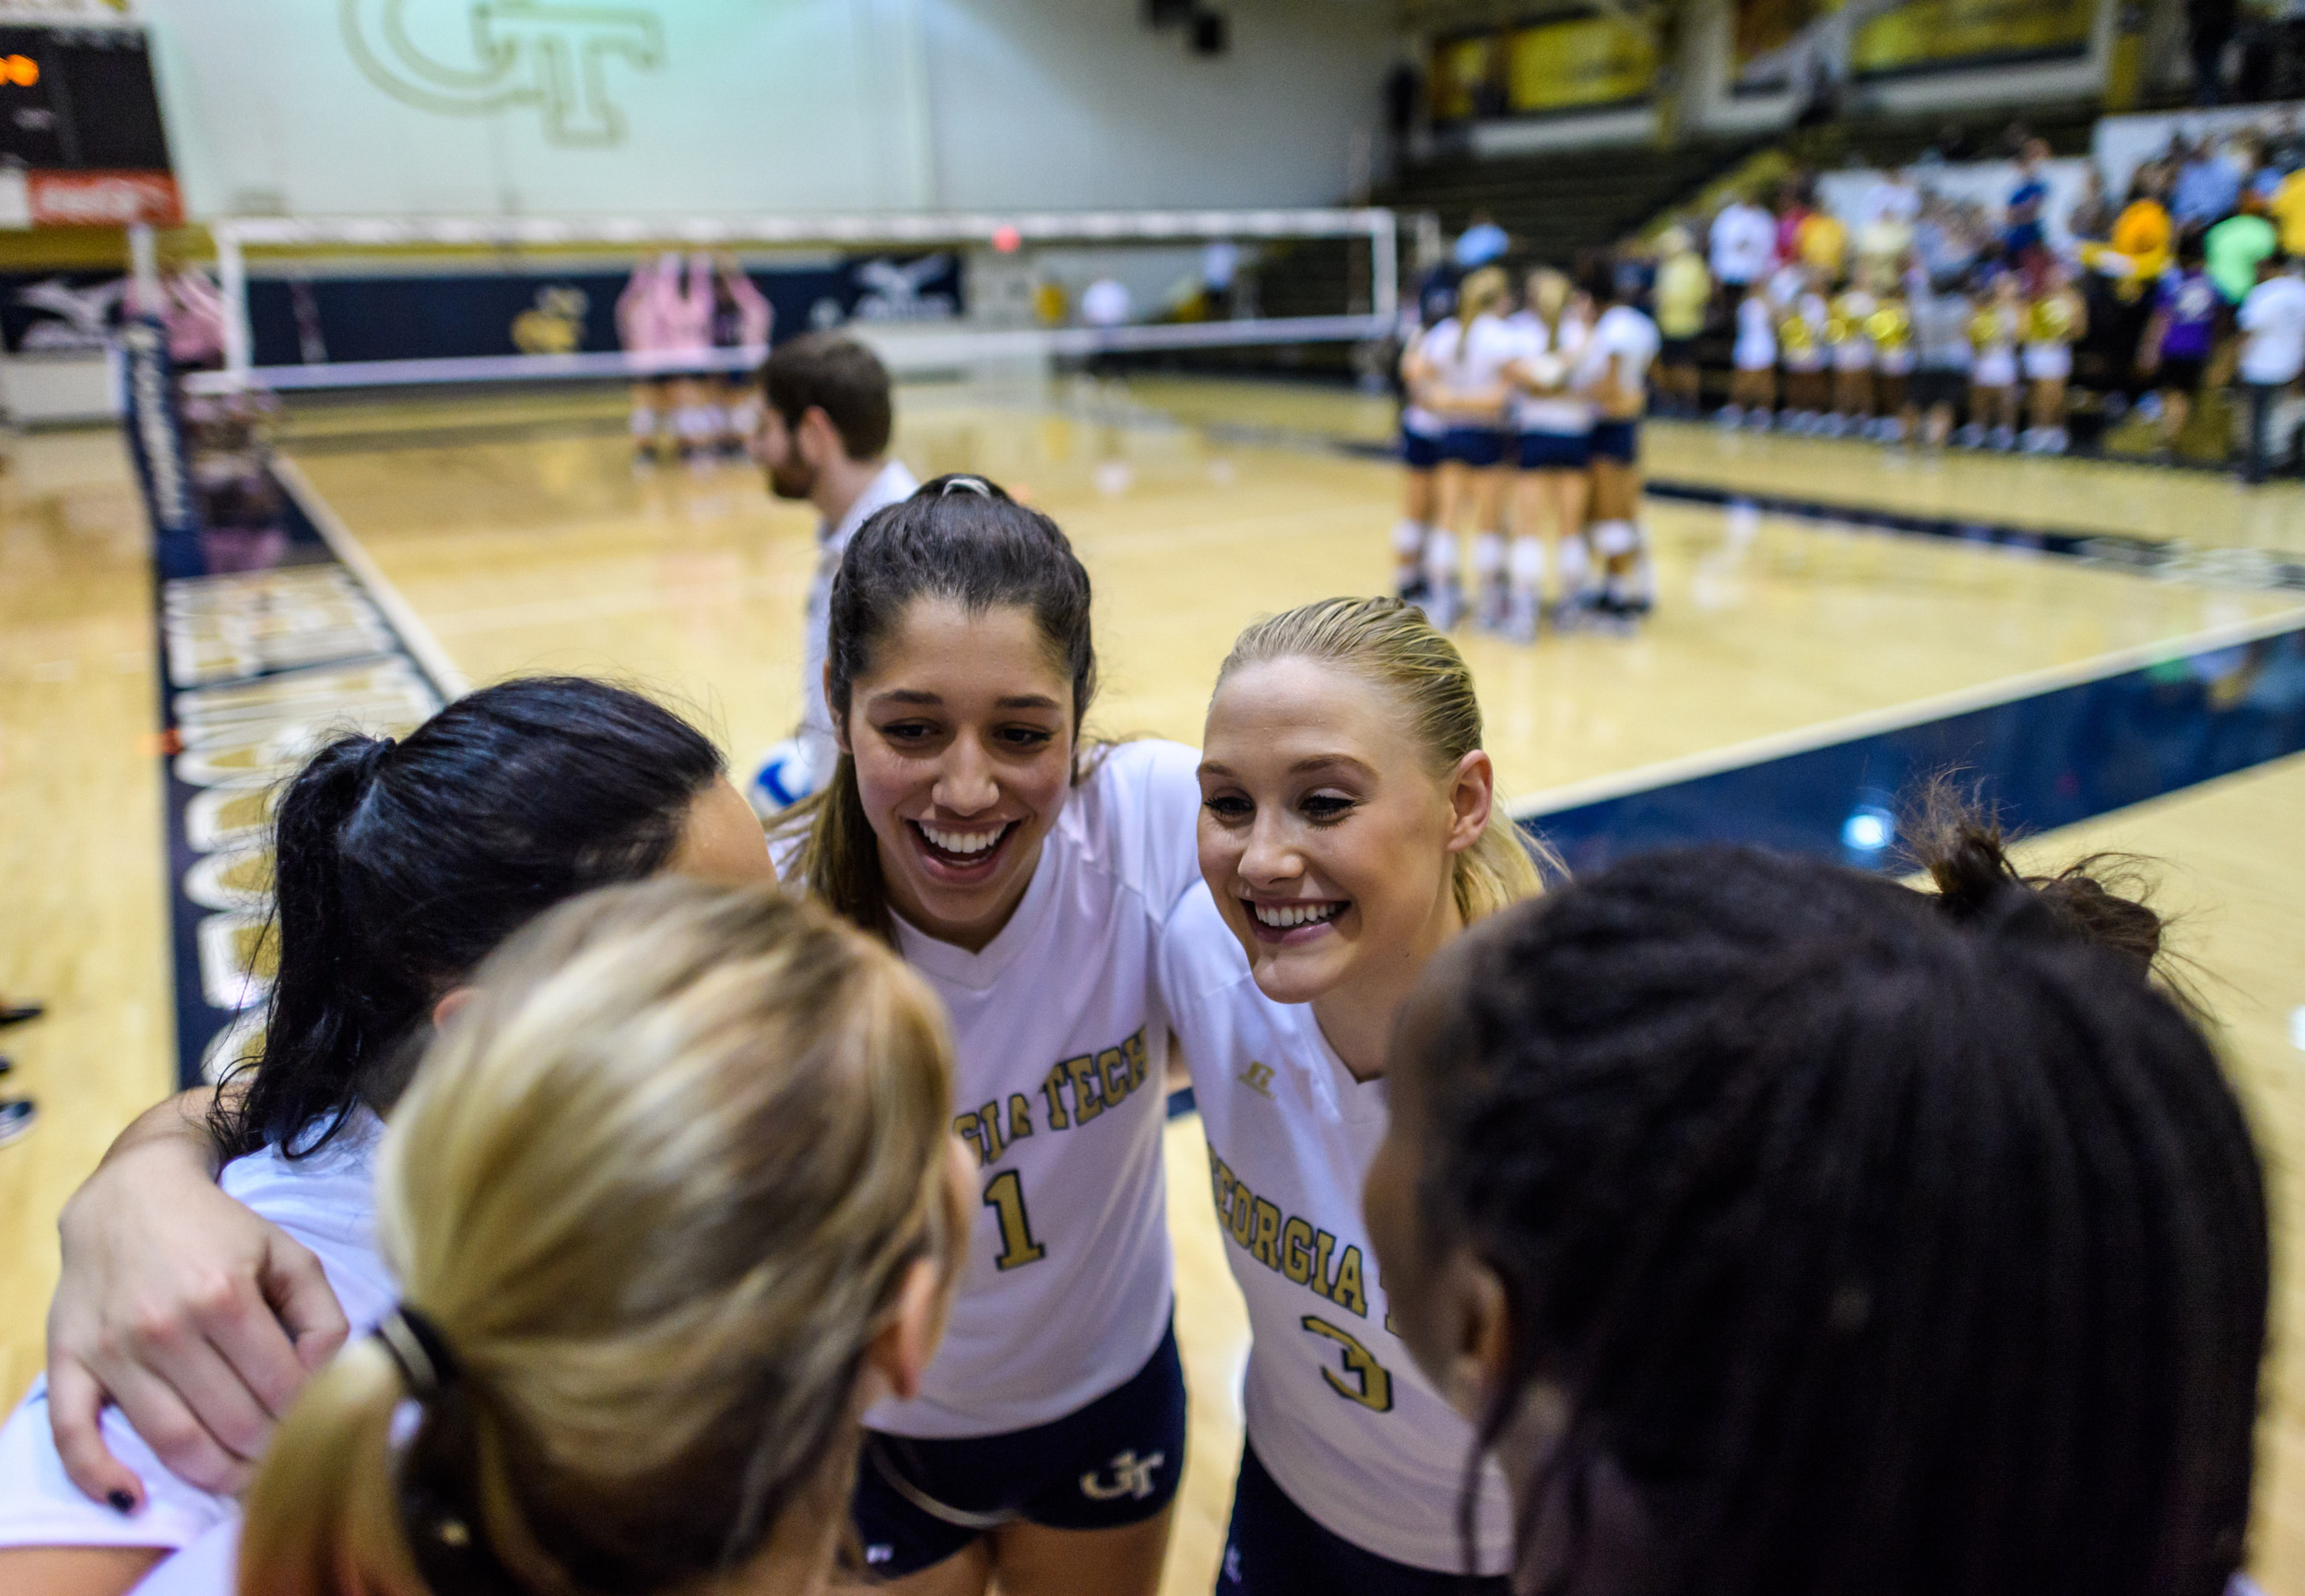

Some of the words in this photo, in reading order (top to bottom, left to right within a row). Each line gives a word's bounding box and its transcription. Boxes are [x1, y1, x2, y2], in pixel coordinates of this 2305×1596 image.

[1039, 1023, 1149, 1131] TECH
[984, 1169, 1046, 1272] 1
[1301, 1315, 1393, 1413] 3
